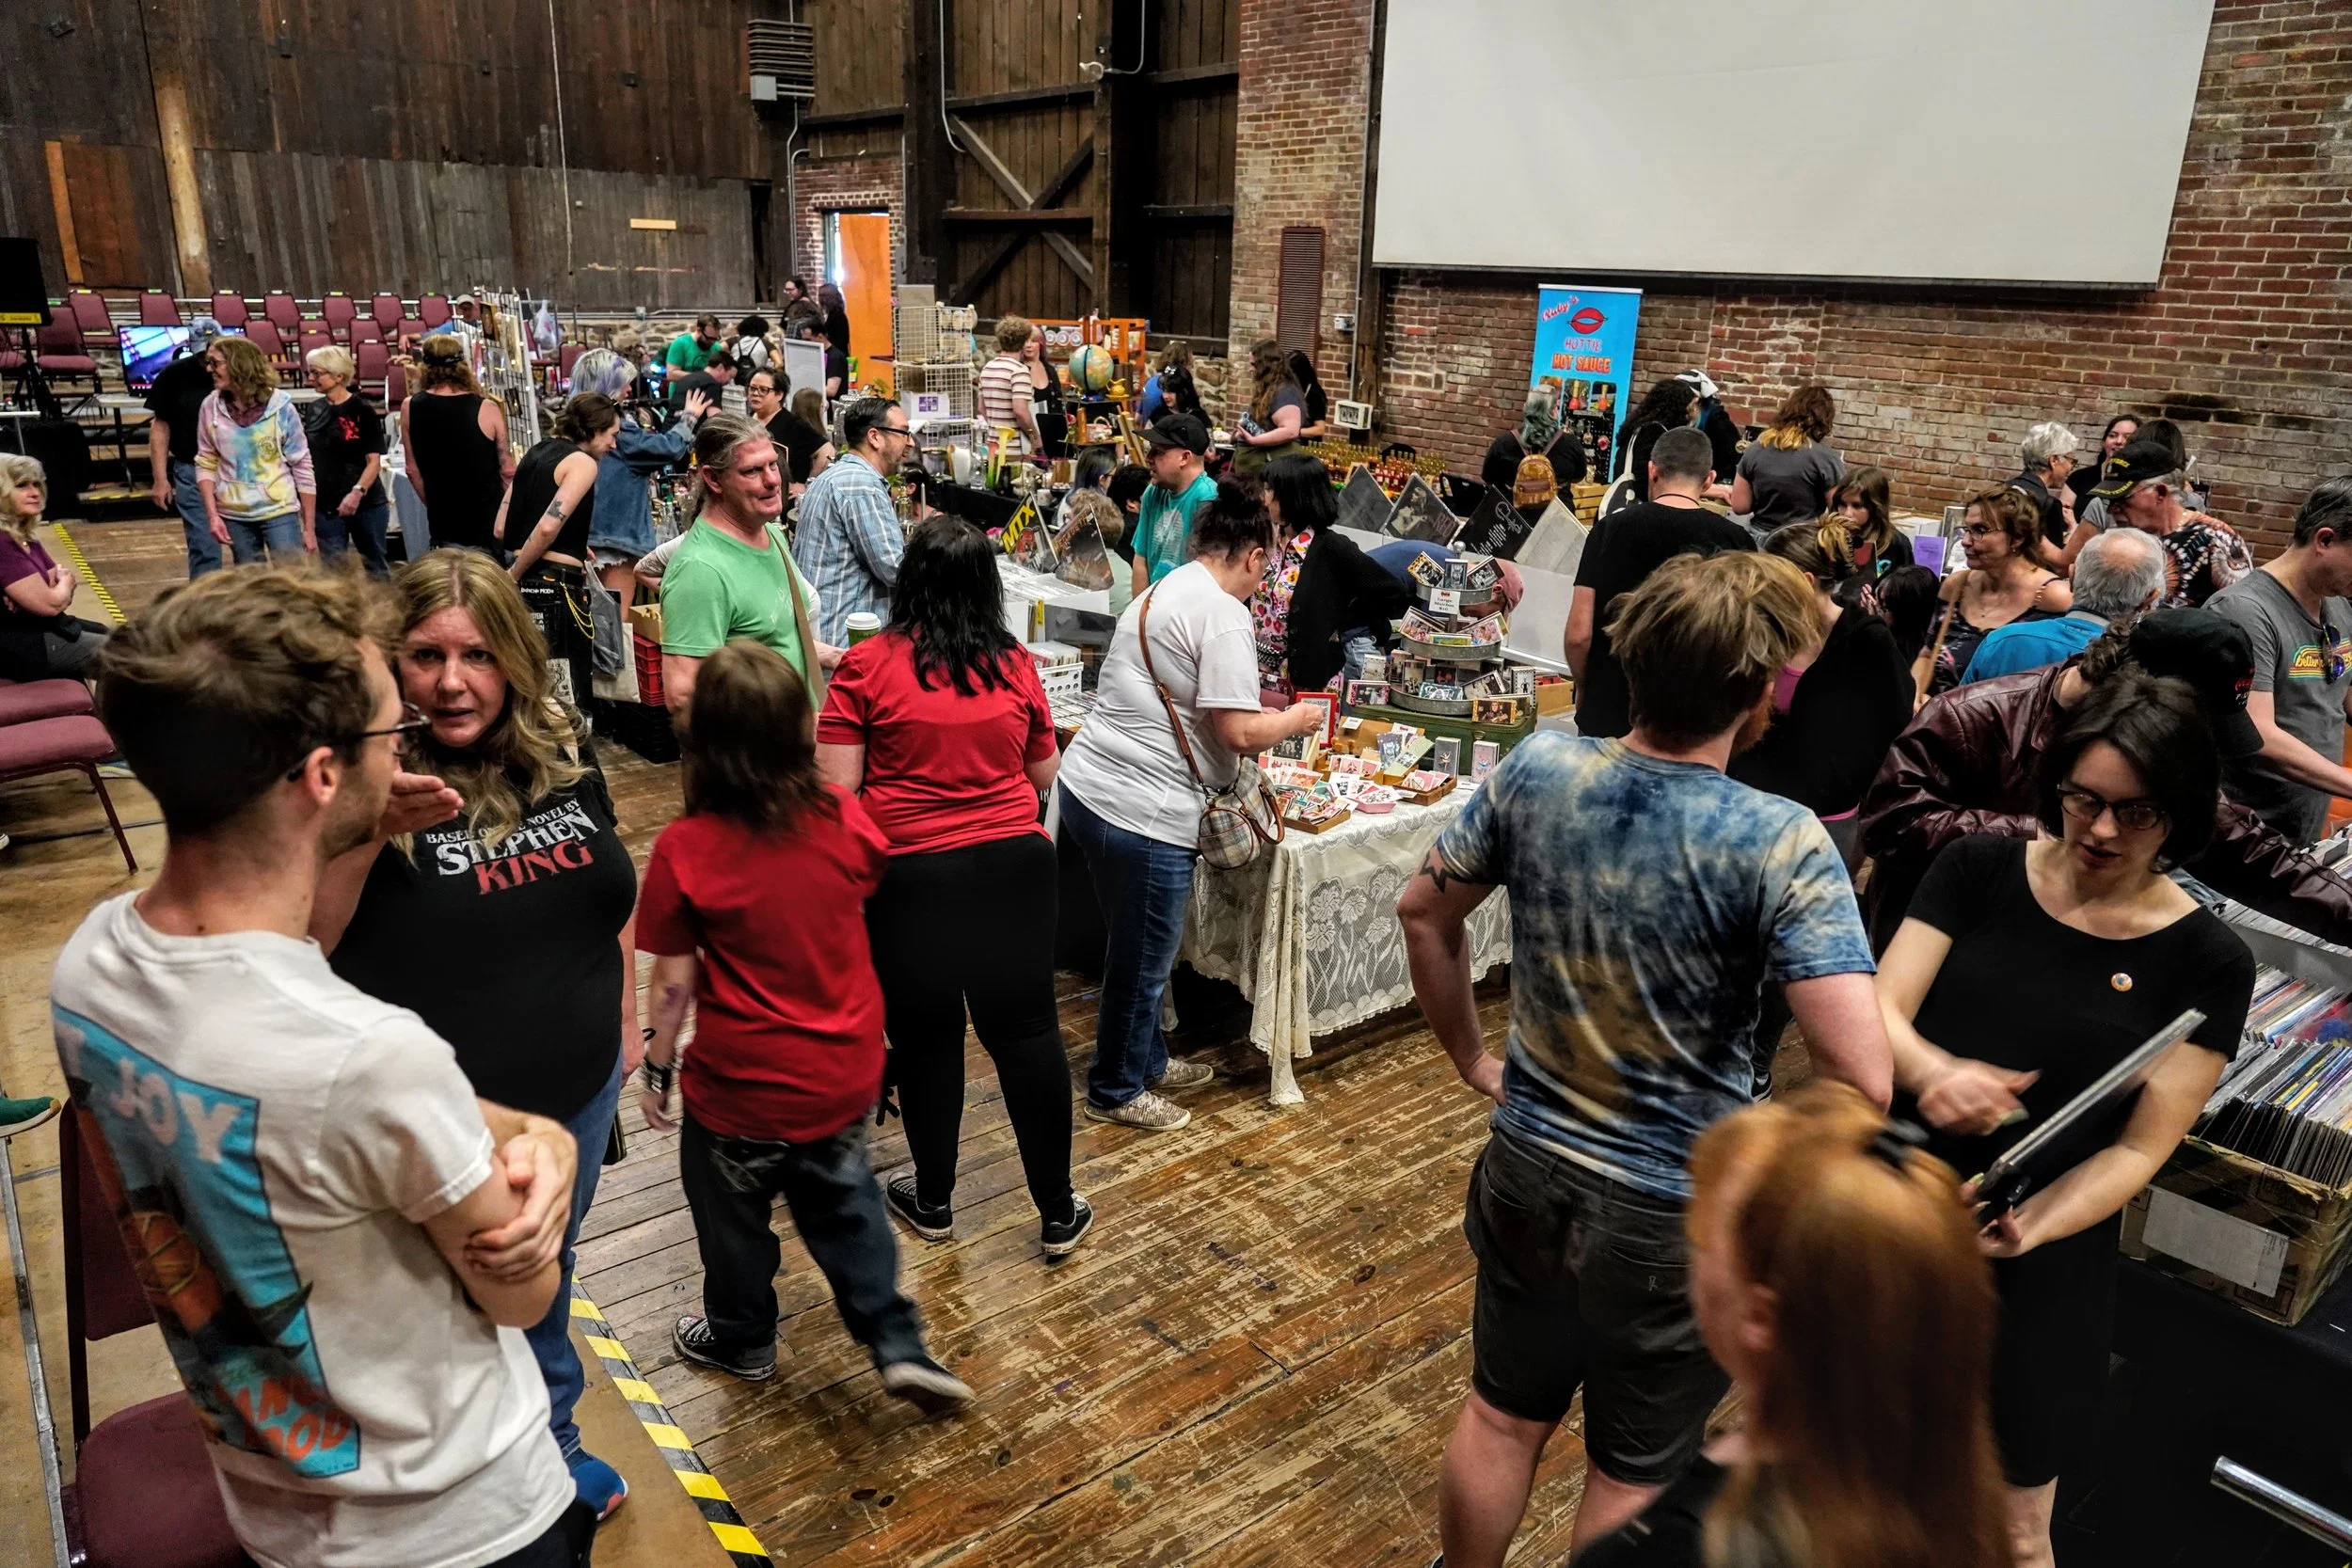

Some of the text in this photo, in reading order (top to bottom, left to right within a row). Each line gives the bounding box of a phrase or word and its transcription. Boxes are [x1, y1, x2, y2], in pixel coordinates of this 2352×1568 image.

[1542, 294, 1580, 322] Ruby's
[1565, 338, 1602, 352] HOTTIE
[1551, 353, 1612, 373] HOT SAUCE
[526, 806, 566, 827] NOVEL
[564, 798, 581, 815] BY
[436, 807, 600, 876] STEPHEN
[473, 839, 595, 895] KING
